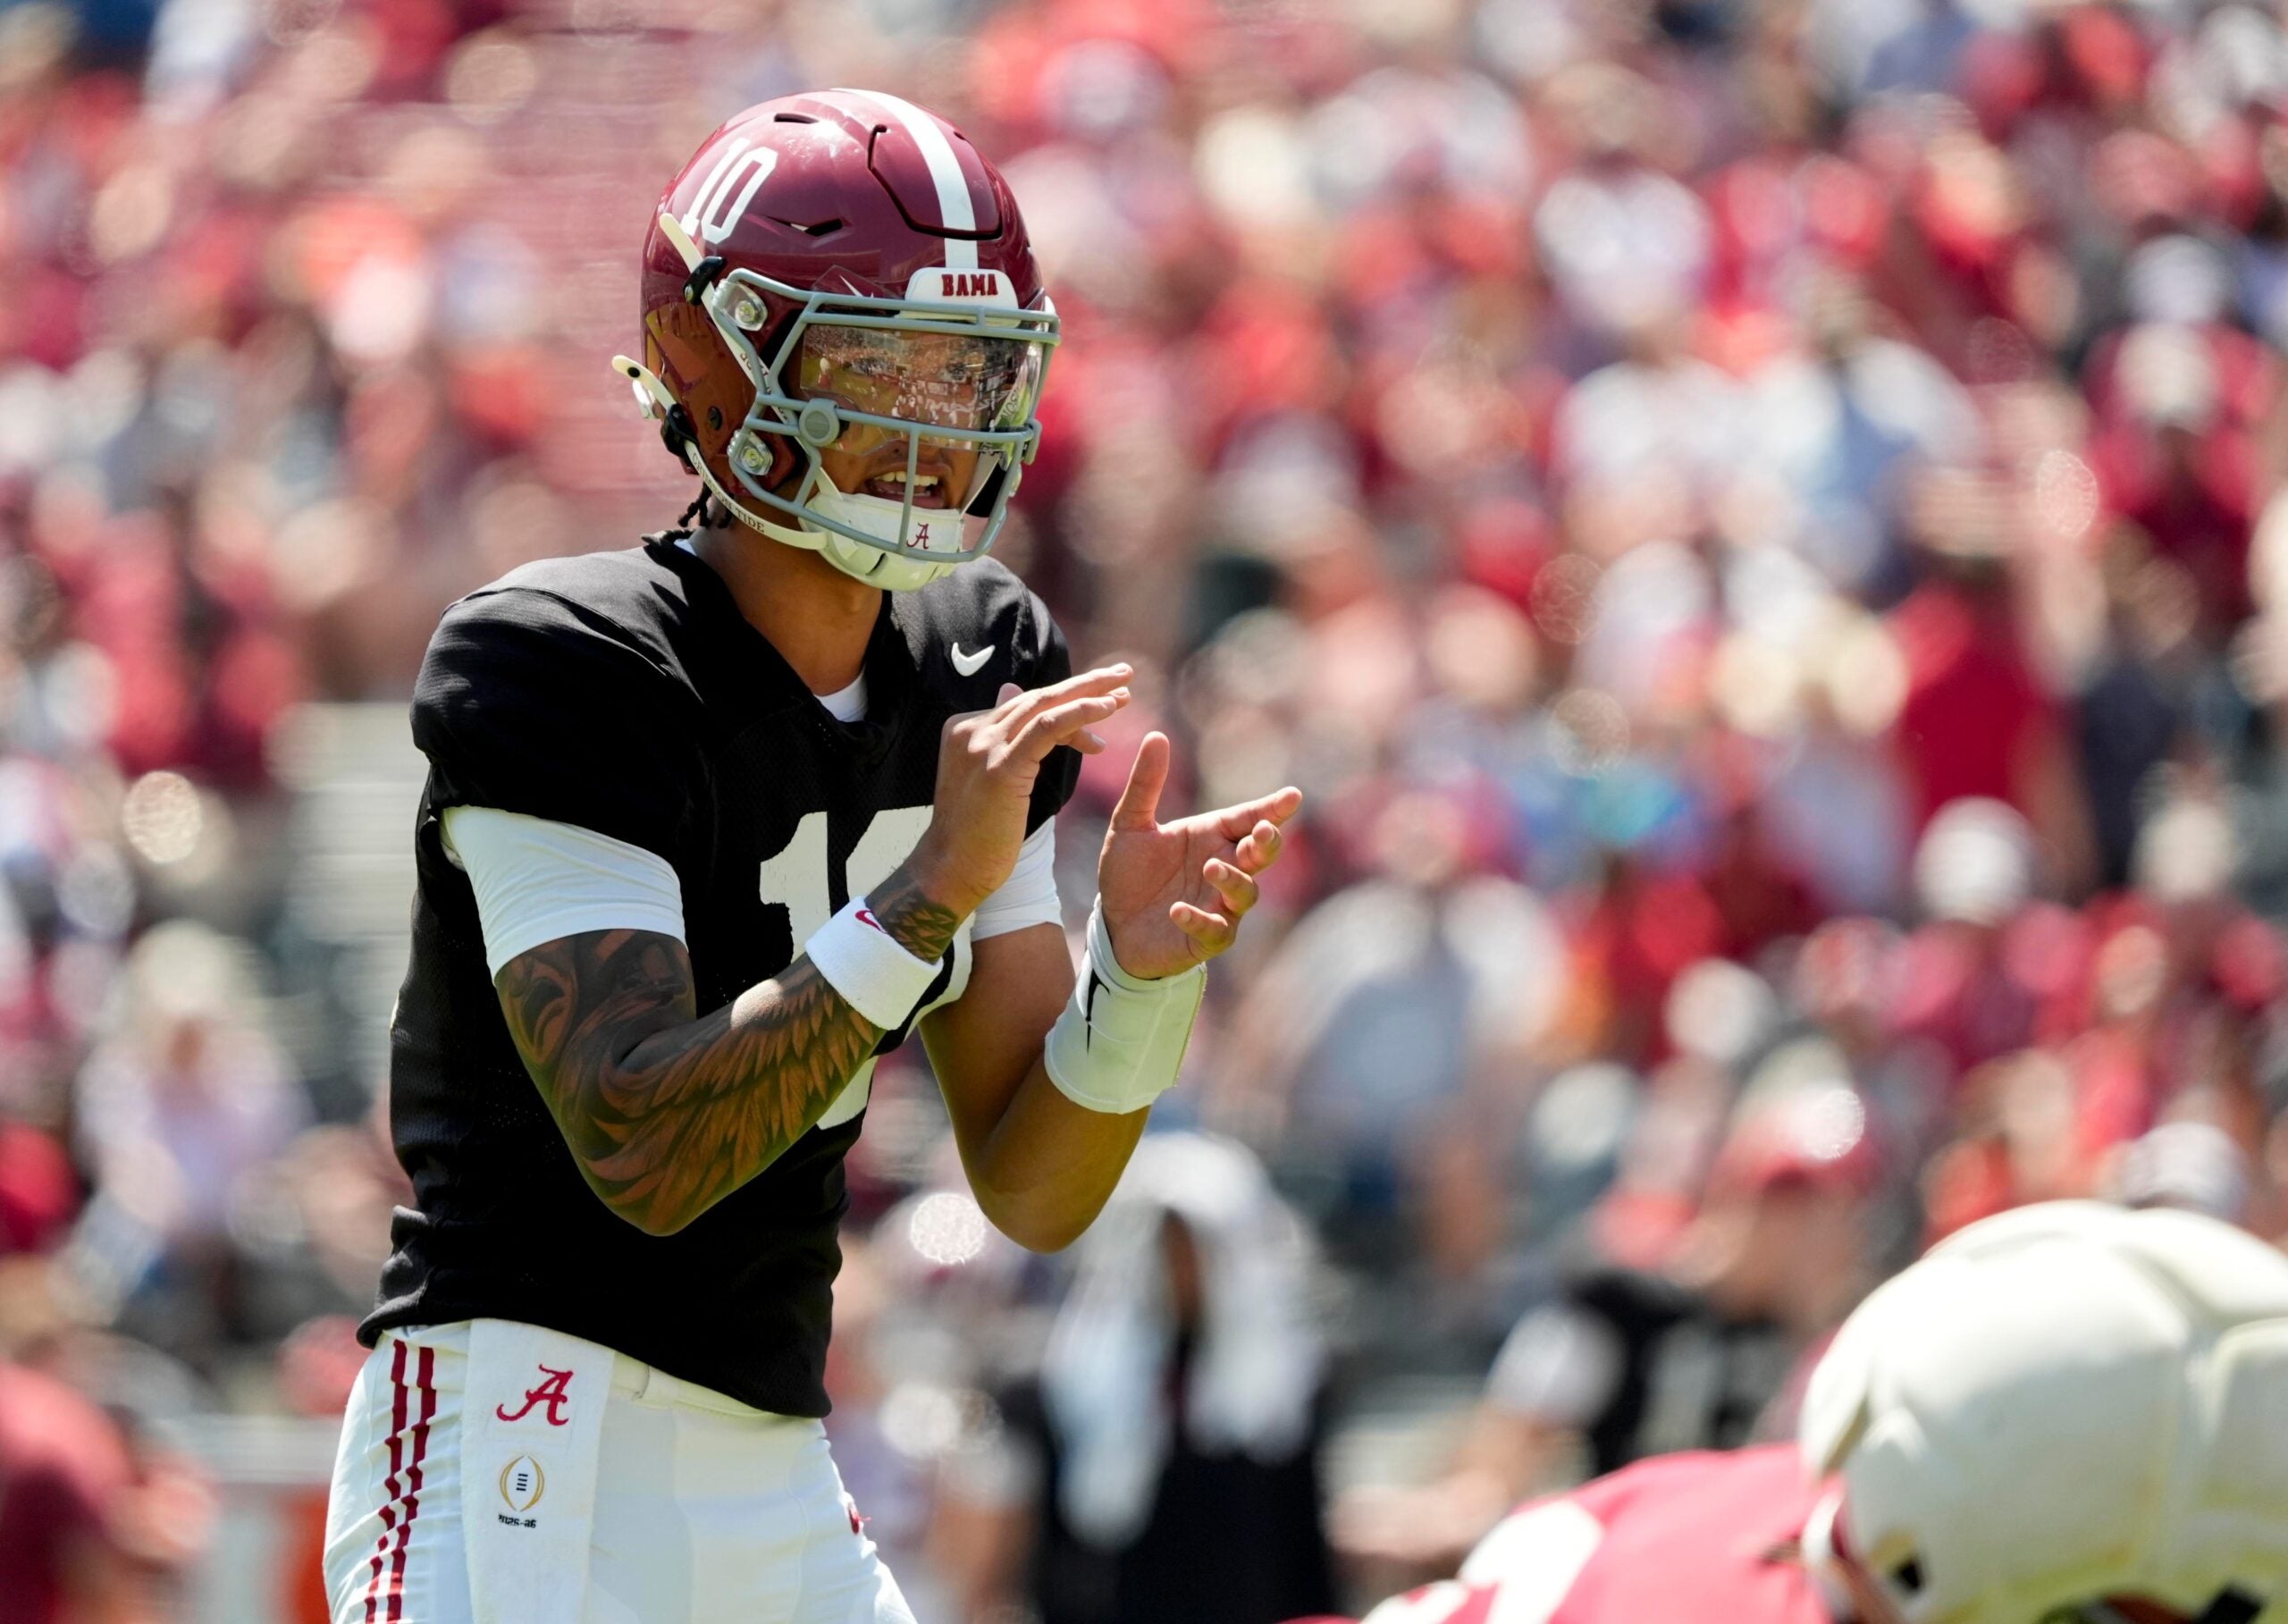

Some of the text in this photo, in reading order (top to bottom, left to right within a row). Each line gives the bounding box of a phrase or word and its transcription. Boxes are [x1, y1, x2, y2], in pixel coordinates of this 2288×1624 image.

[679, 137, 778, 245] 10
[941, 273, 998, 296] BAMA
[735, 507, 765, 533] TIDE
[905, 521, 930, 550] A
[496, 1363, 574, 1426] A
